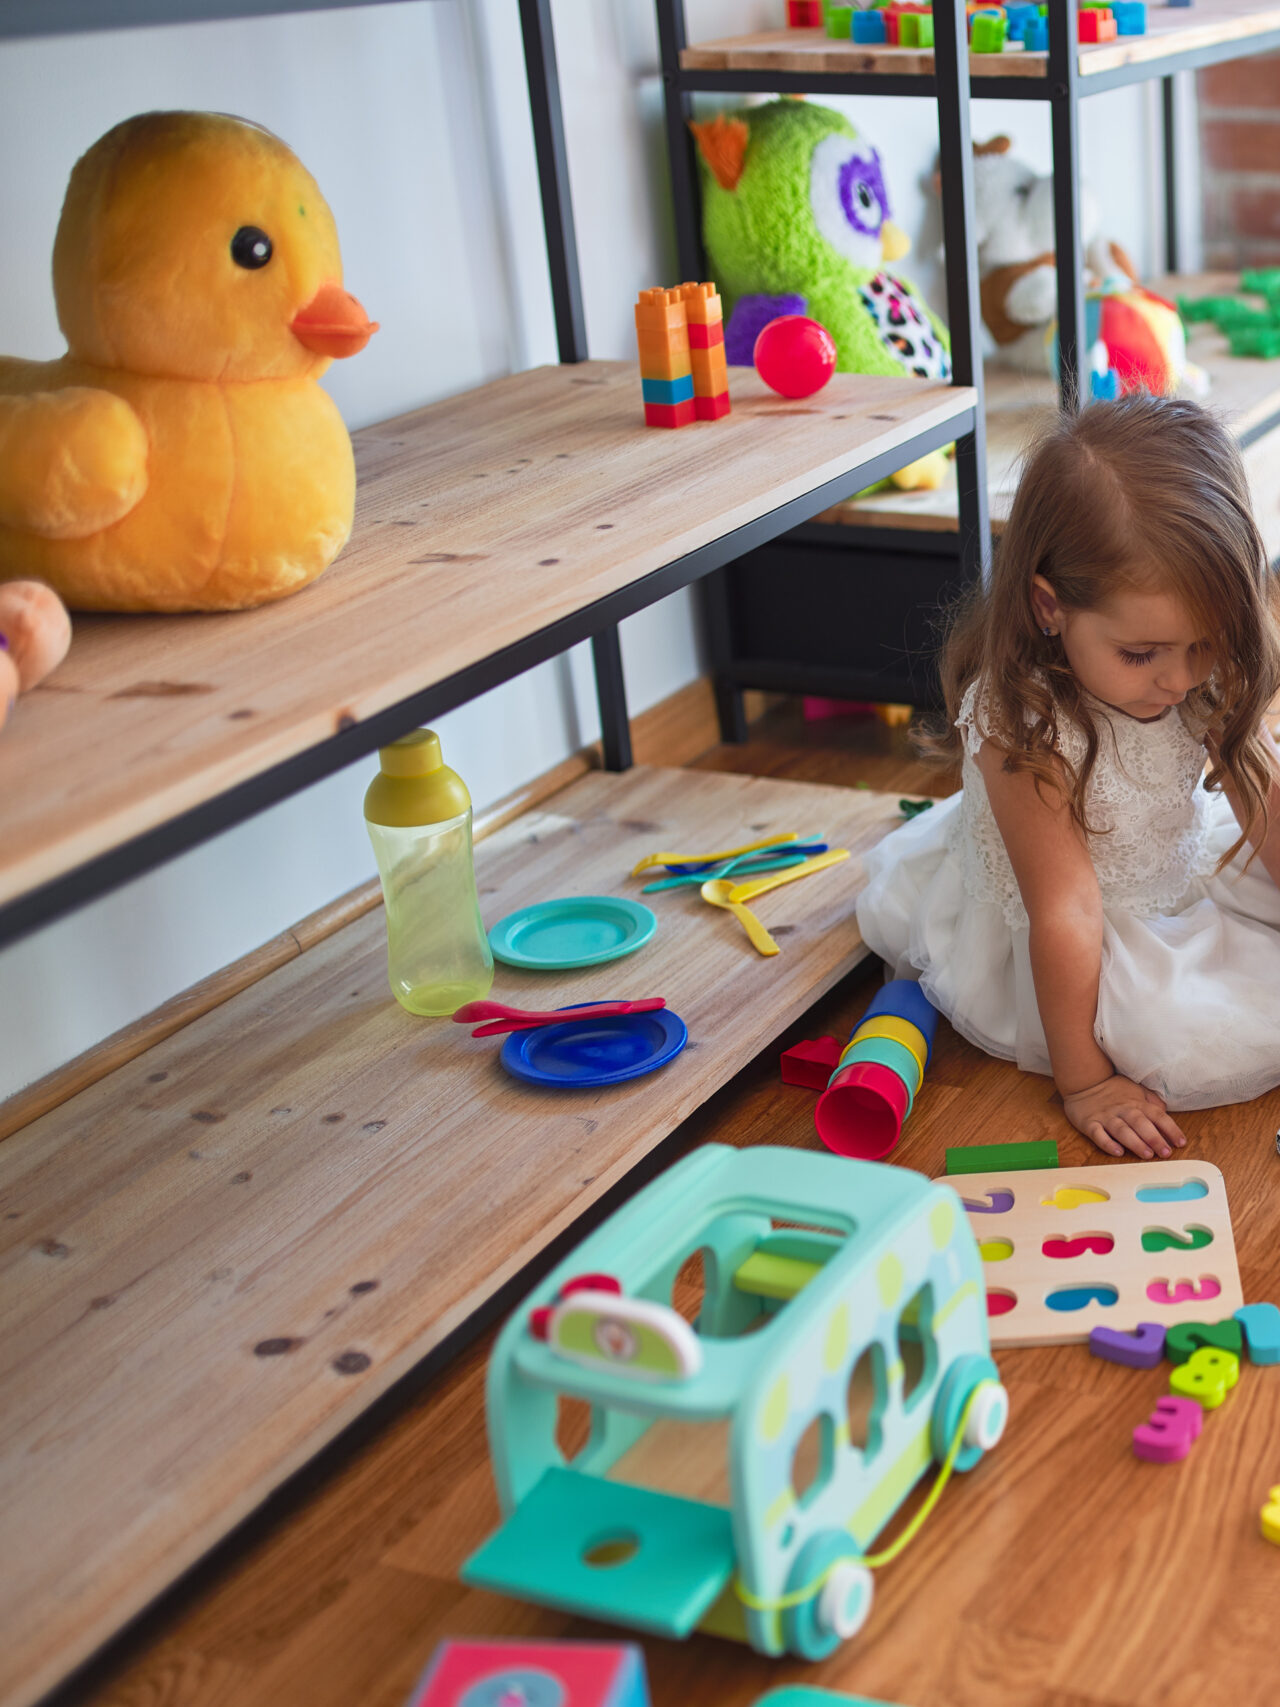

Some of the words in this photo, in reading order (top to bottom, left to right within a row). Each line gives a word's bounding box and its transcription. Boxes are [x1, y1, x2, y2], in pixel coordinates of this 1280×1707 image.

[1041, 1183, 1111, 1210] 4
[1136, 1177, 1209, 1203] 1
[1041, 1230, 1114, 1259] 5
[1141, 1223, 1214, 1253] 2
[1044, 1282, 1119, 1312] 6
[1146, 1274, 1221, 1304] 3
[1089, 1322, 1167, 1370] 7
[1166, 1319, 1242, 1366] 2
[1169, 1346, 1239, 1409] 8
[1133, 1395, 1203, 1463] 3
